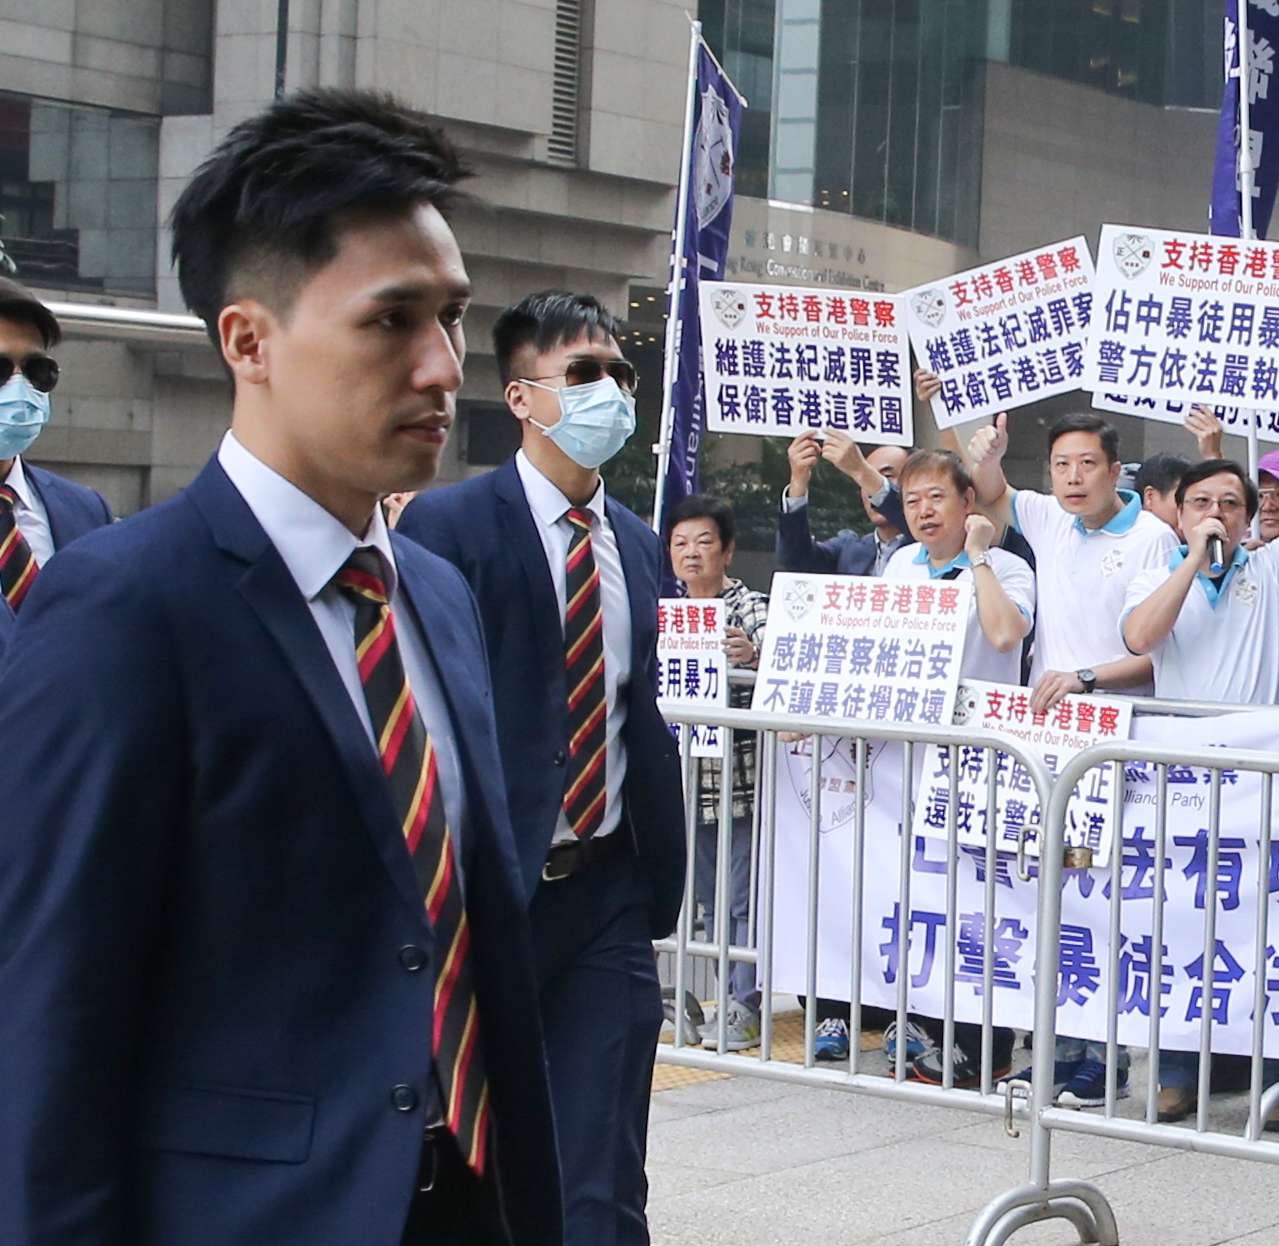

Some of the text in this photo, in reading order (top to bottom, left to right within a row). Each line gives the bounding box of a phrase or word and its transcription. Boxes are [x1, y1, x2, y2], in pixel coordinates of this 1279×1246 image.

[949, 246, 1081, 308] 支持香港警察
[1159, 272, 1175, 287] We
[1178, 274, 1219, 295] Support
[1222, 279, 1232, 293] of
[1234, 280, 1254, 295] Our
[753, 292, 895, 328] 支持香港警察
[957, 308, 972, 321] We
[974, 299, 1006, 317] Support
[1008, 296, 1017, 307] of
[1018, 291, 1033, 305] Our
[1035, 283, 1062, 299] Police
[1063, 275, 1088, 291] Force
[756, 322, 898, 344] We Support of Our Police Force
[926, 292, 1093, 374] 維護法紀滅罪案
[715, 338, 900, 388] 維護法紀滅罪案
[939, 337, 1088, 416] 保衛香港這家
[717, 384, 903, 435] 保衛香港這家園
[823, 581, 960, 615] 支持香港警察
[820, 613, 957, 632] We Support of Our Police Force
[667, 639, 679, 650] Our
[680, 639, 700, 650] Police
[701, 639, 719, 650] Force
[771, 632, 953, 680] 感謝警察維治安
[1033, 732, 1043, 743] of
[1044, 733, 1060, 746] Our
[1171, 792, 1205, 811] Party
